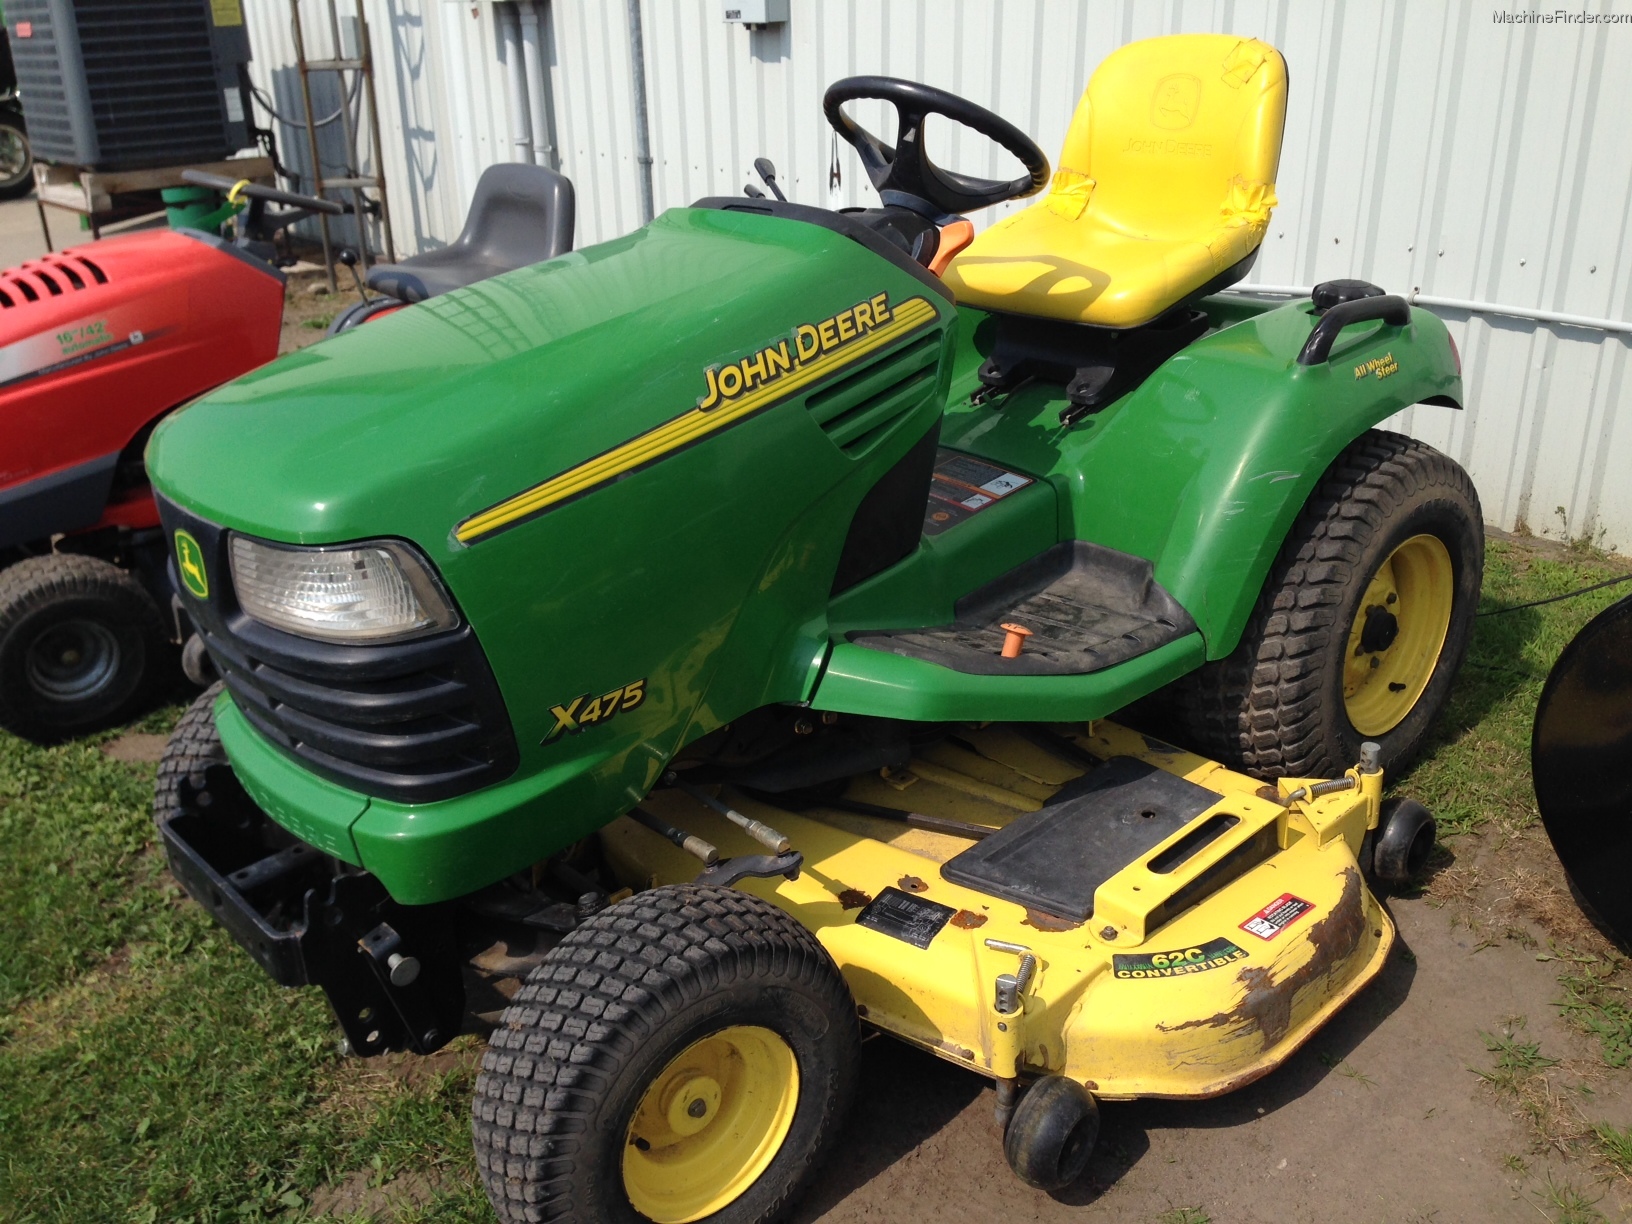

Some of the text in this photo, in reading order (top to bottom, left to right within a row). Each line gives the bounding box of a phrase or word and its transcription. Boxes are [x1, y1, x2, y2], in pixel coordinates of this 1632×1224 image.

[698, 291, 890, 411] JOHN DEERE
[1354, 352, 1393, 380] All Wheel
[1375, 362, 1398, 380] Steer
[542, 677, 647, 744] X475
[1117, 949, 1246, 978] CONVERTIBLE
[1151, 948, 1206, 969] 62C
